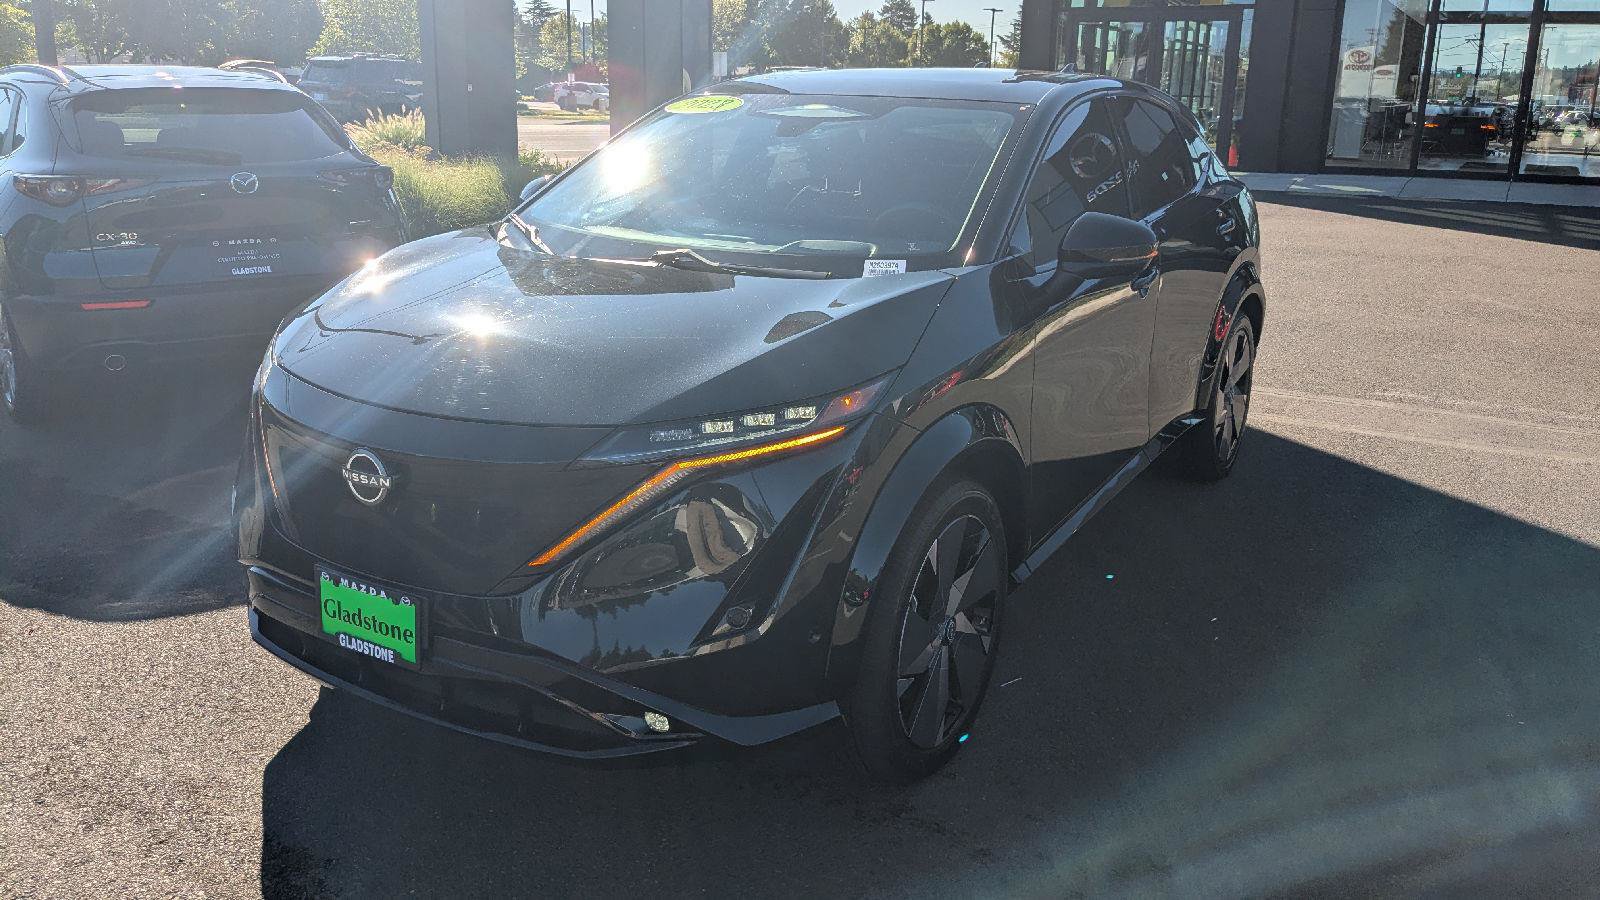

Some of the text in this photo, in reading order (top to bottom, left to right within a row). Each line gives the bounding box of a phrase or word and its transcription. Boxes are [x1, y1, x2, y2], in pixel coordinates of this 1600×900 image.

[96, 232, 138, 241] CX-30
[232, 266, 273, 275] GLADSTONE
[342, 468, 390, 487] NISSAN
[340, 577, 388, 599] MAZDA
[323, 598, 414, 645] Gladstone
[339, 633, 395, 664] GLADSTONE
